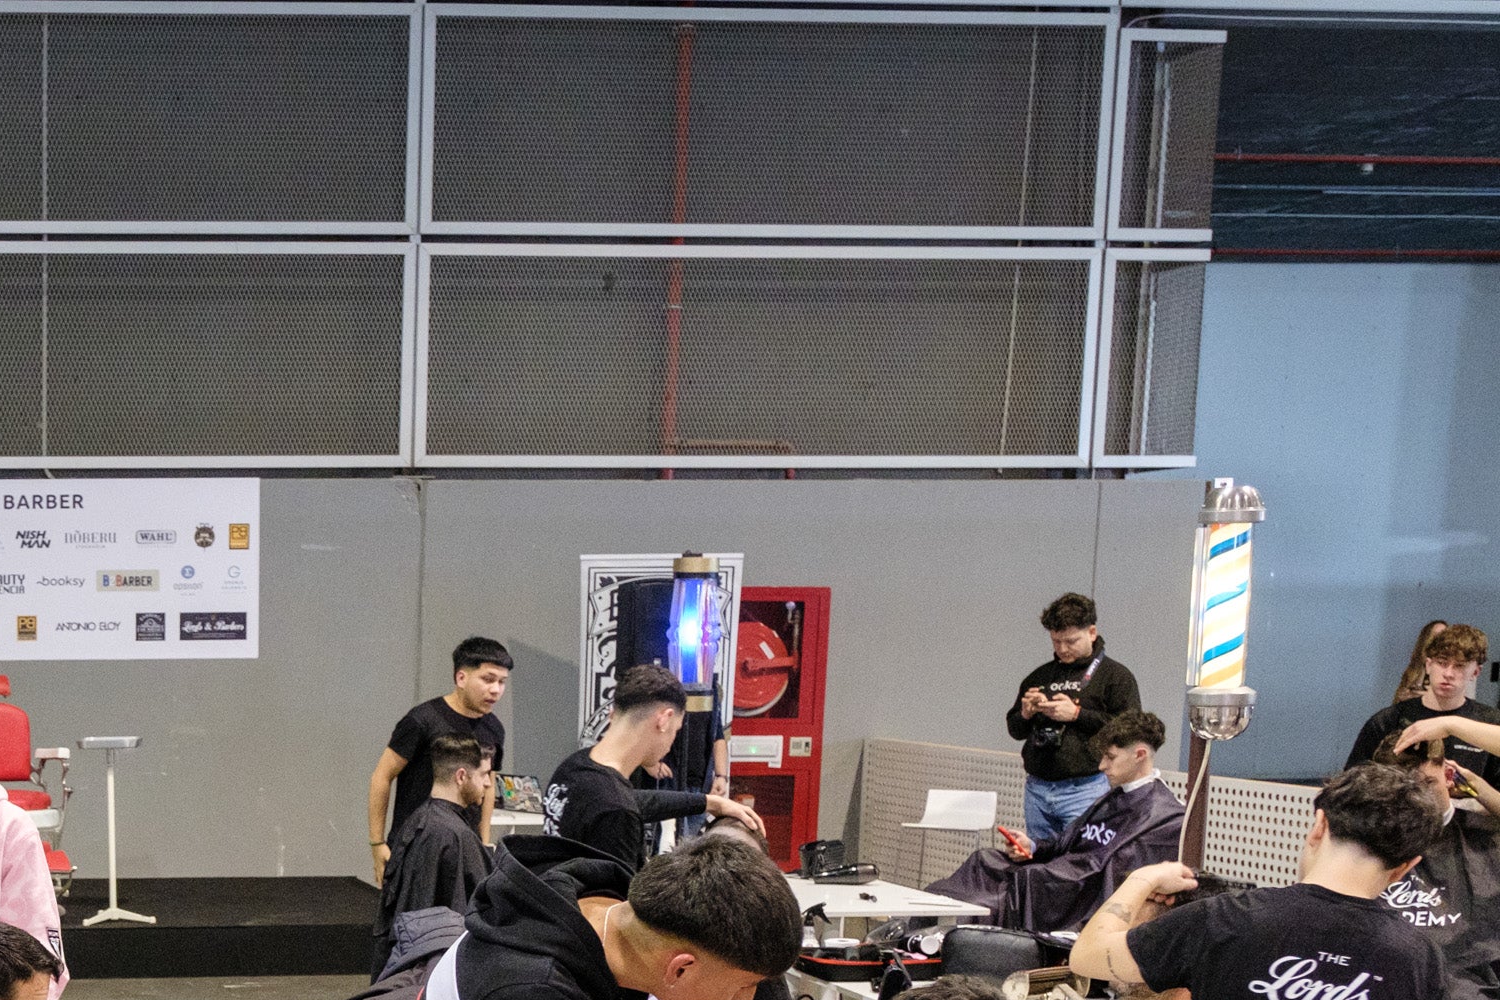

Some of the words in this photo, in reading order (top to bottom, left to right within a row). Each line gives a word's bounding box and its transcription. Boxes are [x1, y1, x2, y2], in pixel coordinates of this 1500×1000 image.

[3, 494, 84, 509] BARBER
[15, 530, 46, 541] NISH
[140, 532, 173, 541] WAHL
[20, 539, 51, 549] MAN
[37, 576, 86, 587] booksy
[55, 622, 97, 632] ANTONIO
[99, 621, 121, 631] ELOY
[1379, 881, 1442, 908] Lords
[1402, 911, 1462, 926] DEMY
[1318, 951, 1352, 966] THE
